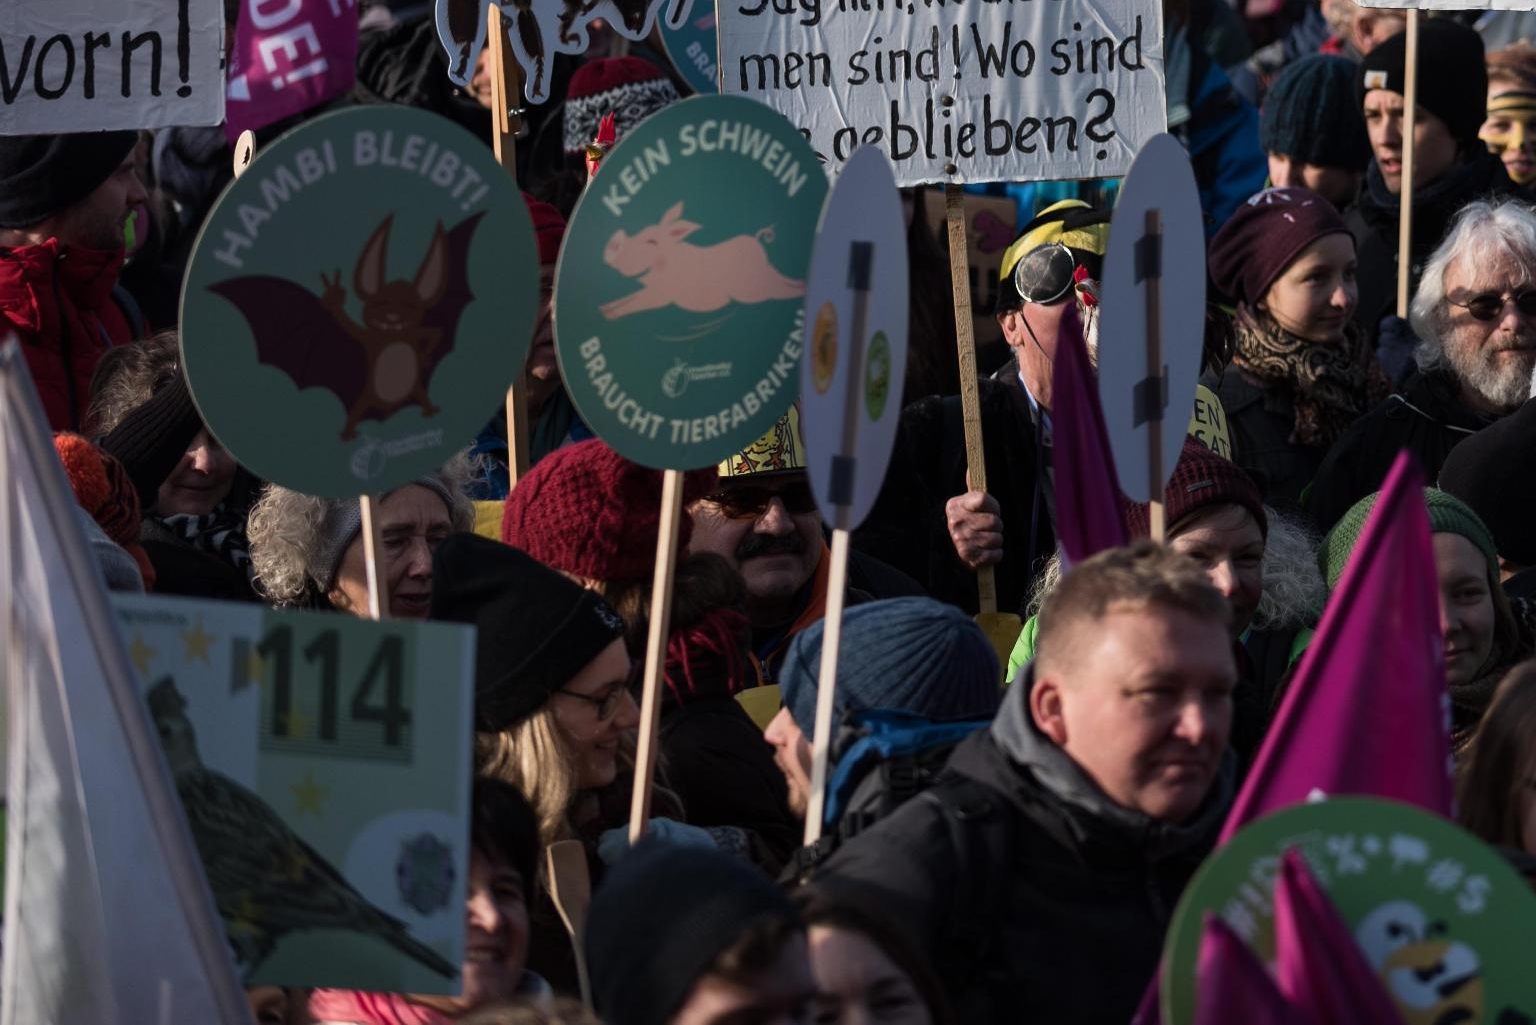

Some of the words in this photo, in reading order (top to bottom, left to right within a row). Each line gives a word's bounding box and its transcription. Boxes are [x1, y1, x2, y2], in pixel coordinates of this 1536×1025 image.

[739, 49, 832, 92] men
[970, 20, 1036, 79] Wo
[1050, 14, 1146, 76] sind
[213, 139, 338, 269] HAMBI
[353, 129, 490, 212] BLEIBT!
[602, 137, 672, 217] KEIN
[679, 119, 808, 198] SCHWEIN
[579, 335, 666, 440] BRAUCHT
[669, 308, 806, 445] TIERFABRIKEN!
[256, 622, 413, 748] 114
